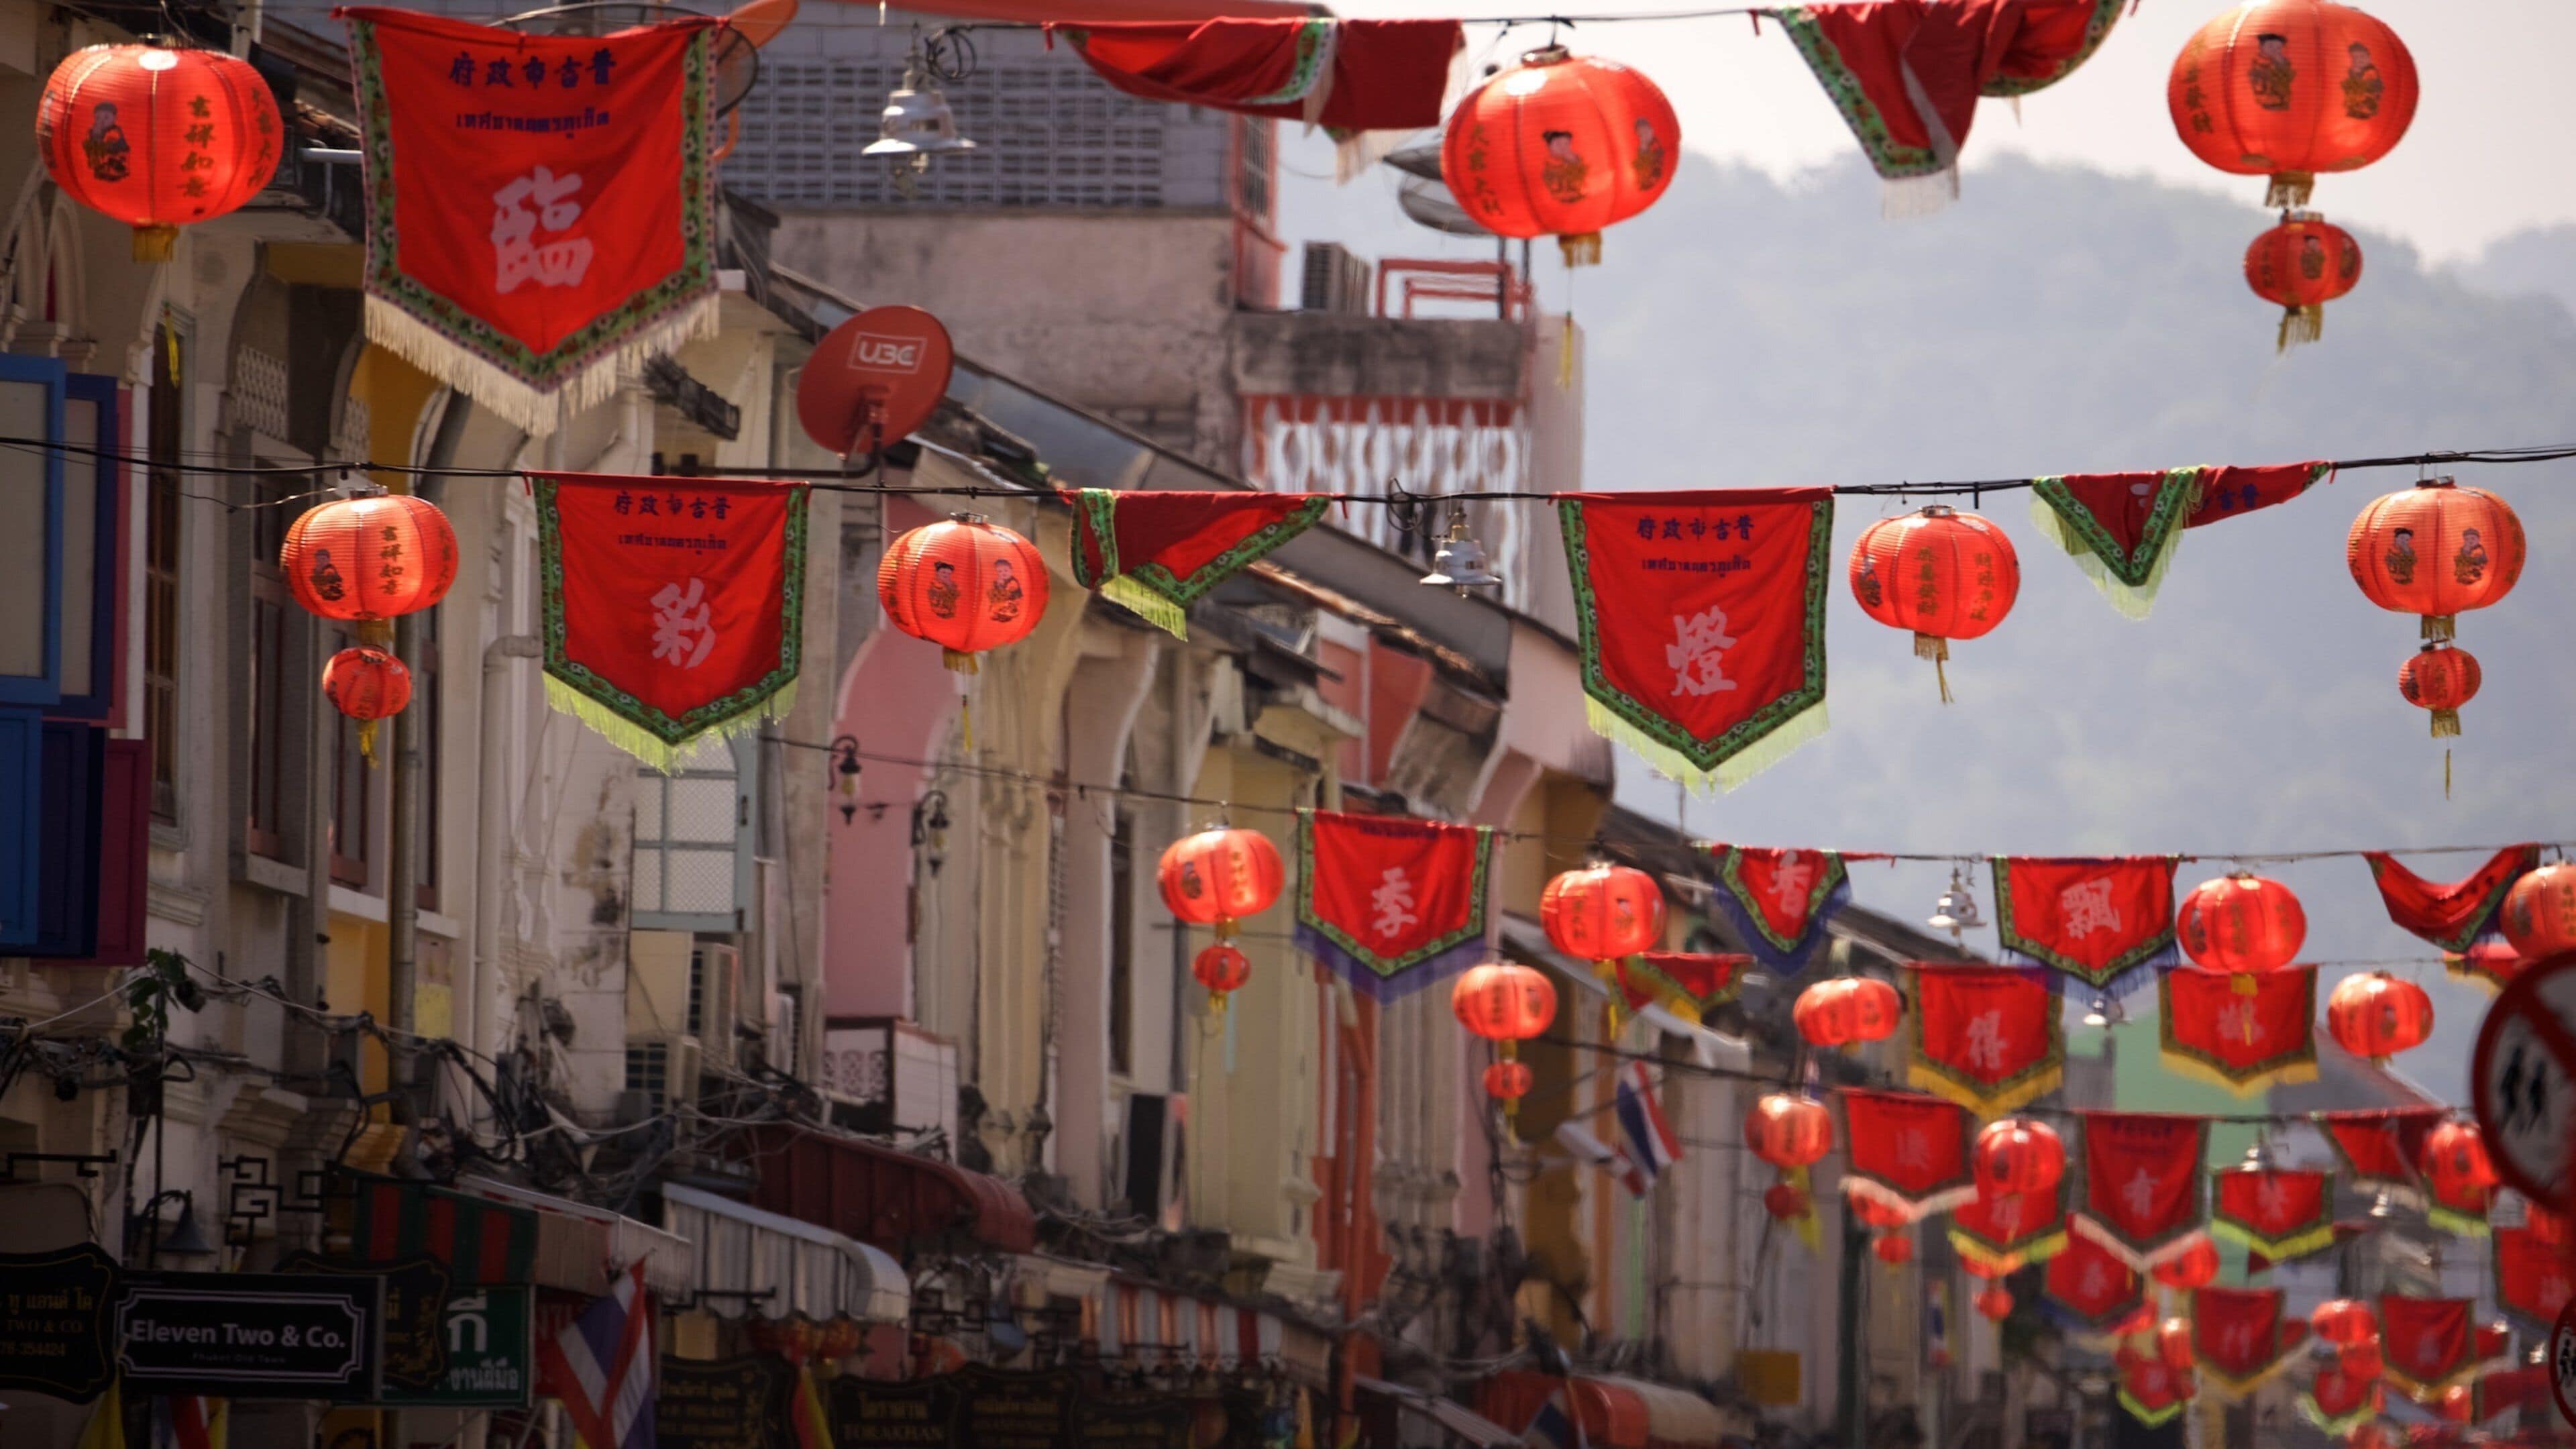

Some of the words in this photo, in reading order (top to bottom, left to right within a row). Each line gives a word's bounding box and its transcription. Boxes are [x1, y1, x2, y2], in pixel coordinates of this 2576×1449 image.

[491, 165, 594, 294] 臨
[650, 577, 716, 669] 彩
[1371, 866, 1418, 938] 季
[6, 1319, 40, 1333] TWO
[129, 1318, 216, 1343] Eleven
[221, 1322, 276, 1347] Two
[280, 1324, 301, 1348] &
[305, 1325, 347, 1348] Co.
